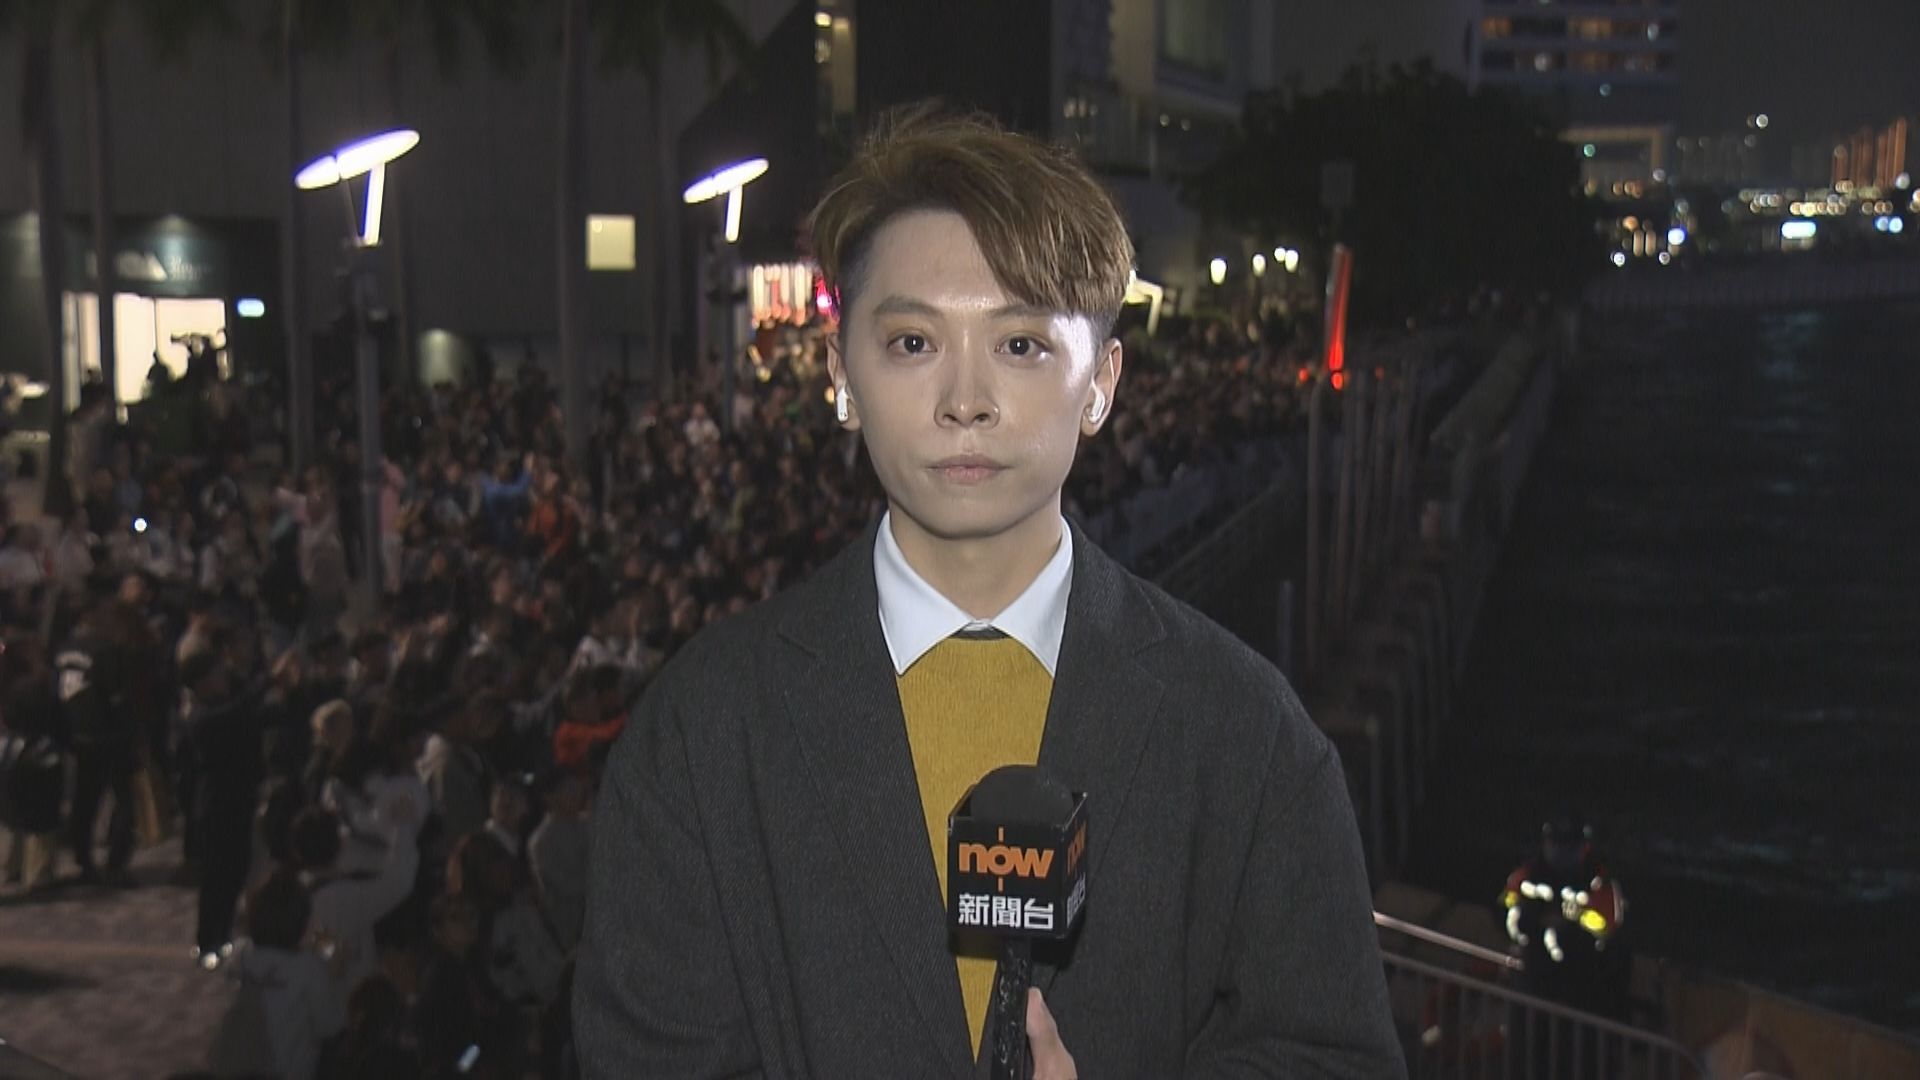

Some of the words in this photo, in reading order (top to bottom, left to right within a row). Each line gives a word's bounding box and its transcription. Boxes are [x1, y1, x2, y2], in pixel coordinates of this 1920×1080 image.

[957, 841, 1055, 879] now
[957, 892, 1054, 931] 新聞台
